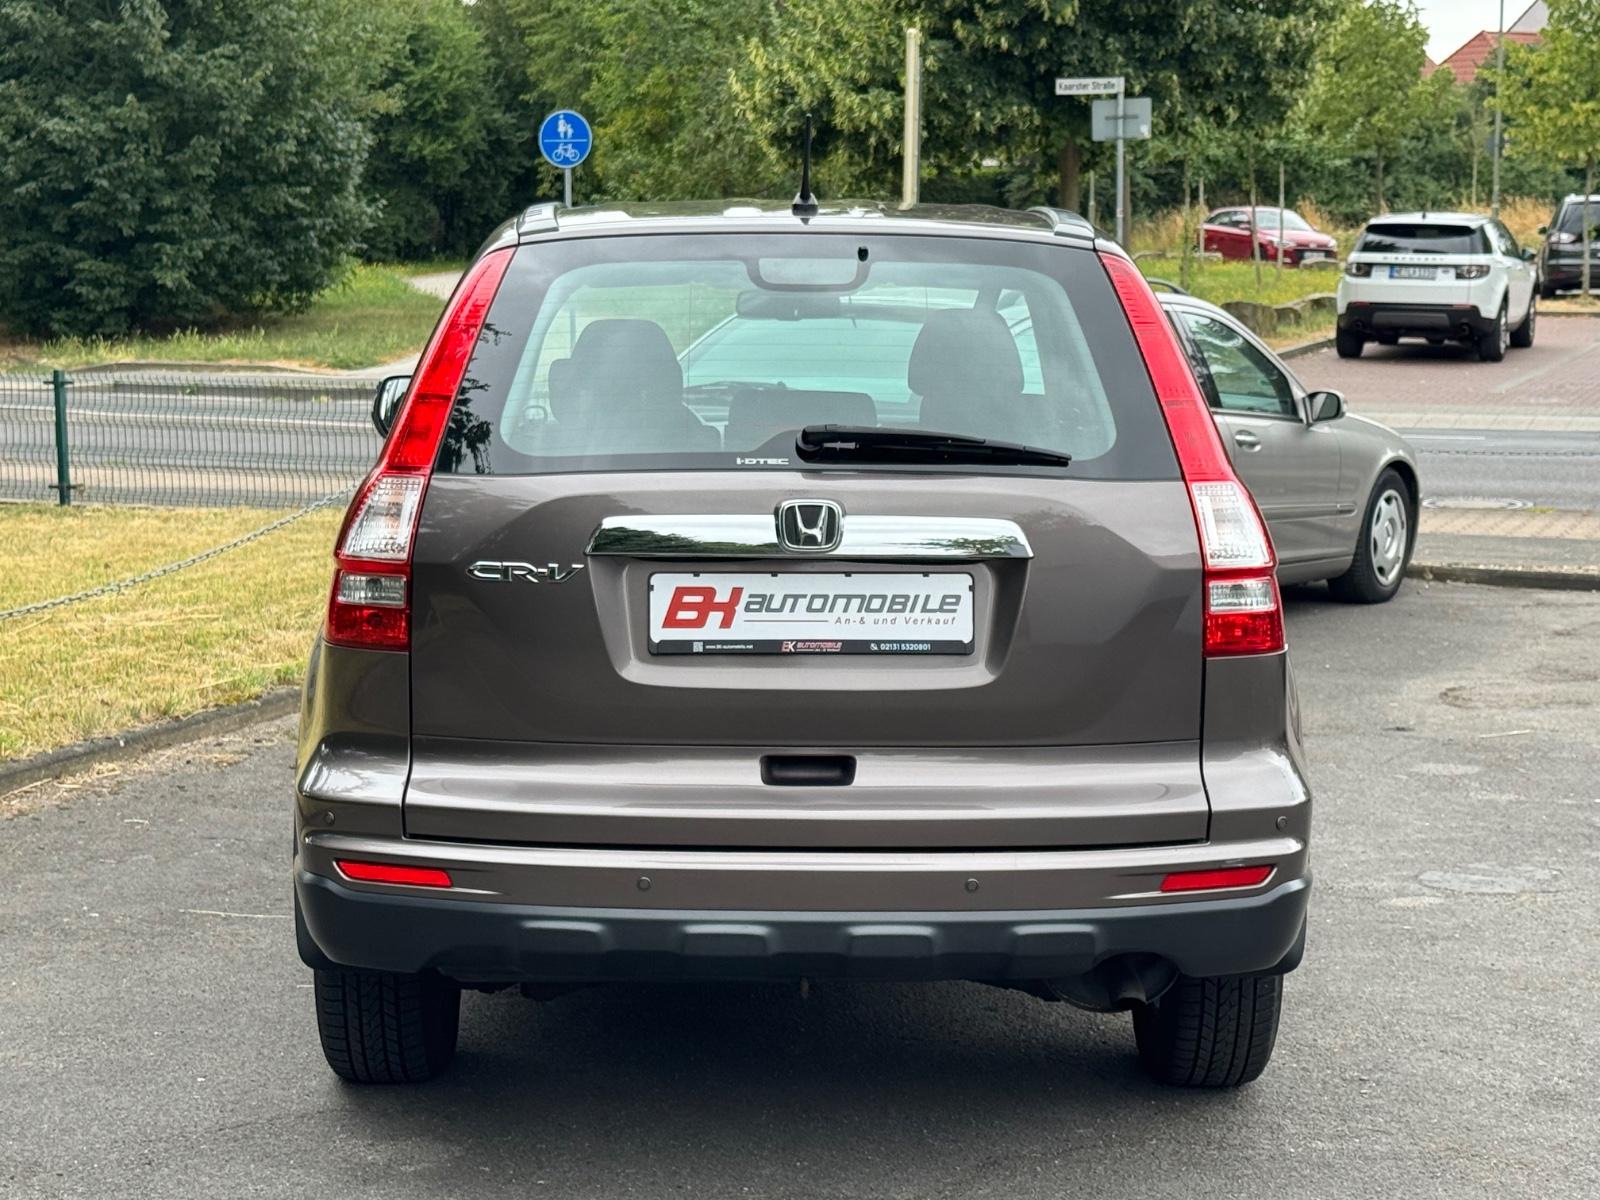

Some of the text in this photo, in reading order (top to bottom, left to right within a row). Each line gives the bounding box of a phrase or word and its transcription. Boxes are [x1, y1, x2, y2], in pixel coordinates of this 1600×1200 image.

[1091, 80, 1115, 90] Straße
[466, 560, 585, 583] CR-V
[661, 586, 744, 629] BK
[873, 616, 897, 625] und
[904, 616, 956, 625] Verkauf
[880, 643, 900, 651] 02131
